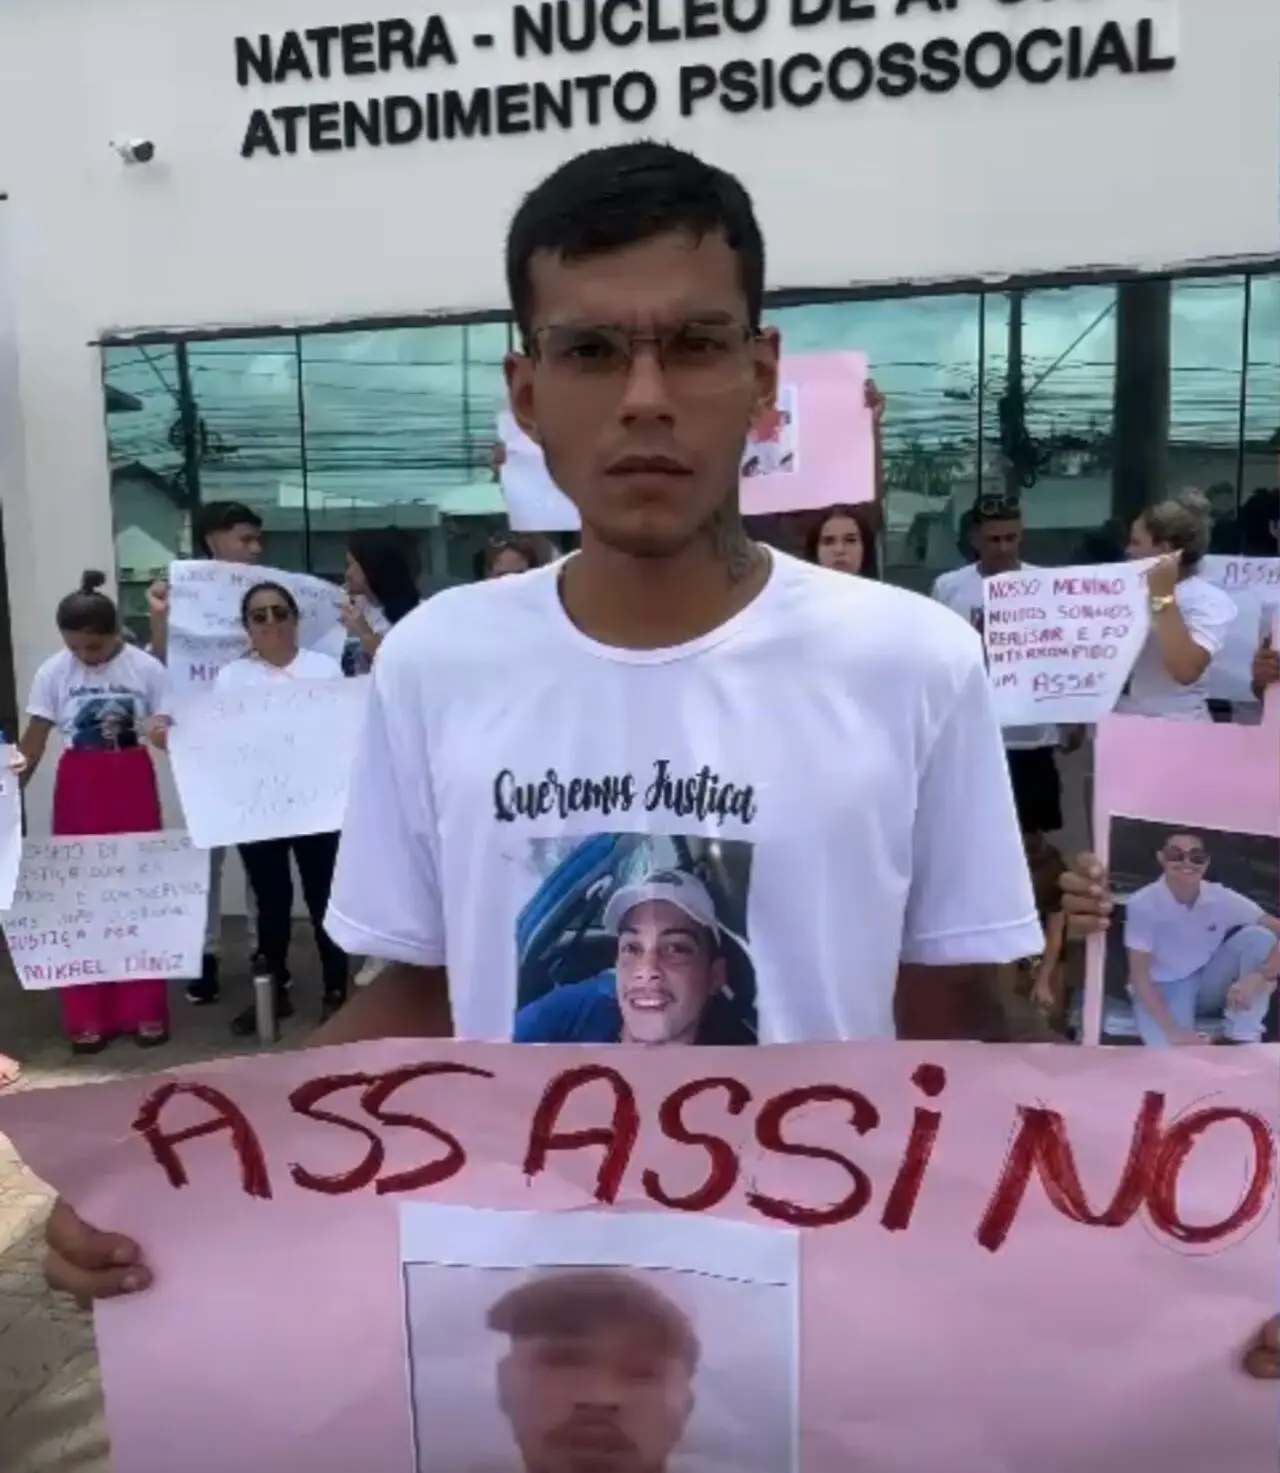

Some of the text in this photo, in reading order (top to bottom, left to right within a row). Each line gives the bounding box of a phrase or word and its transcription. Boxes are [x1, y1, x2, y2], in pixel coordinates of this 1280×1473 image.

[234, 15, 458, 86] NATERA
[239, 18, 1177, 158] ATENDIMENTO PSICOSSOCIAL
[644, 759, 757, 827] Justiça
[23, 957, 107, 982] MIKAEL
